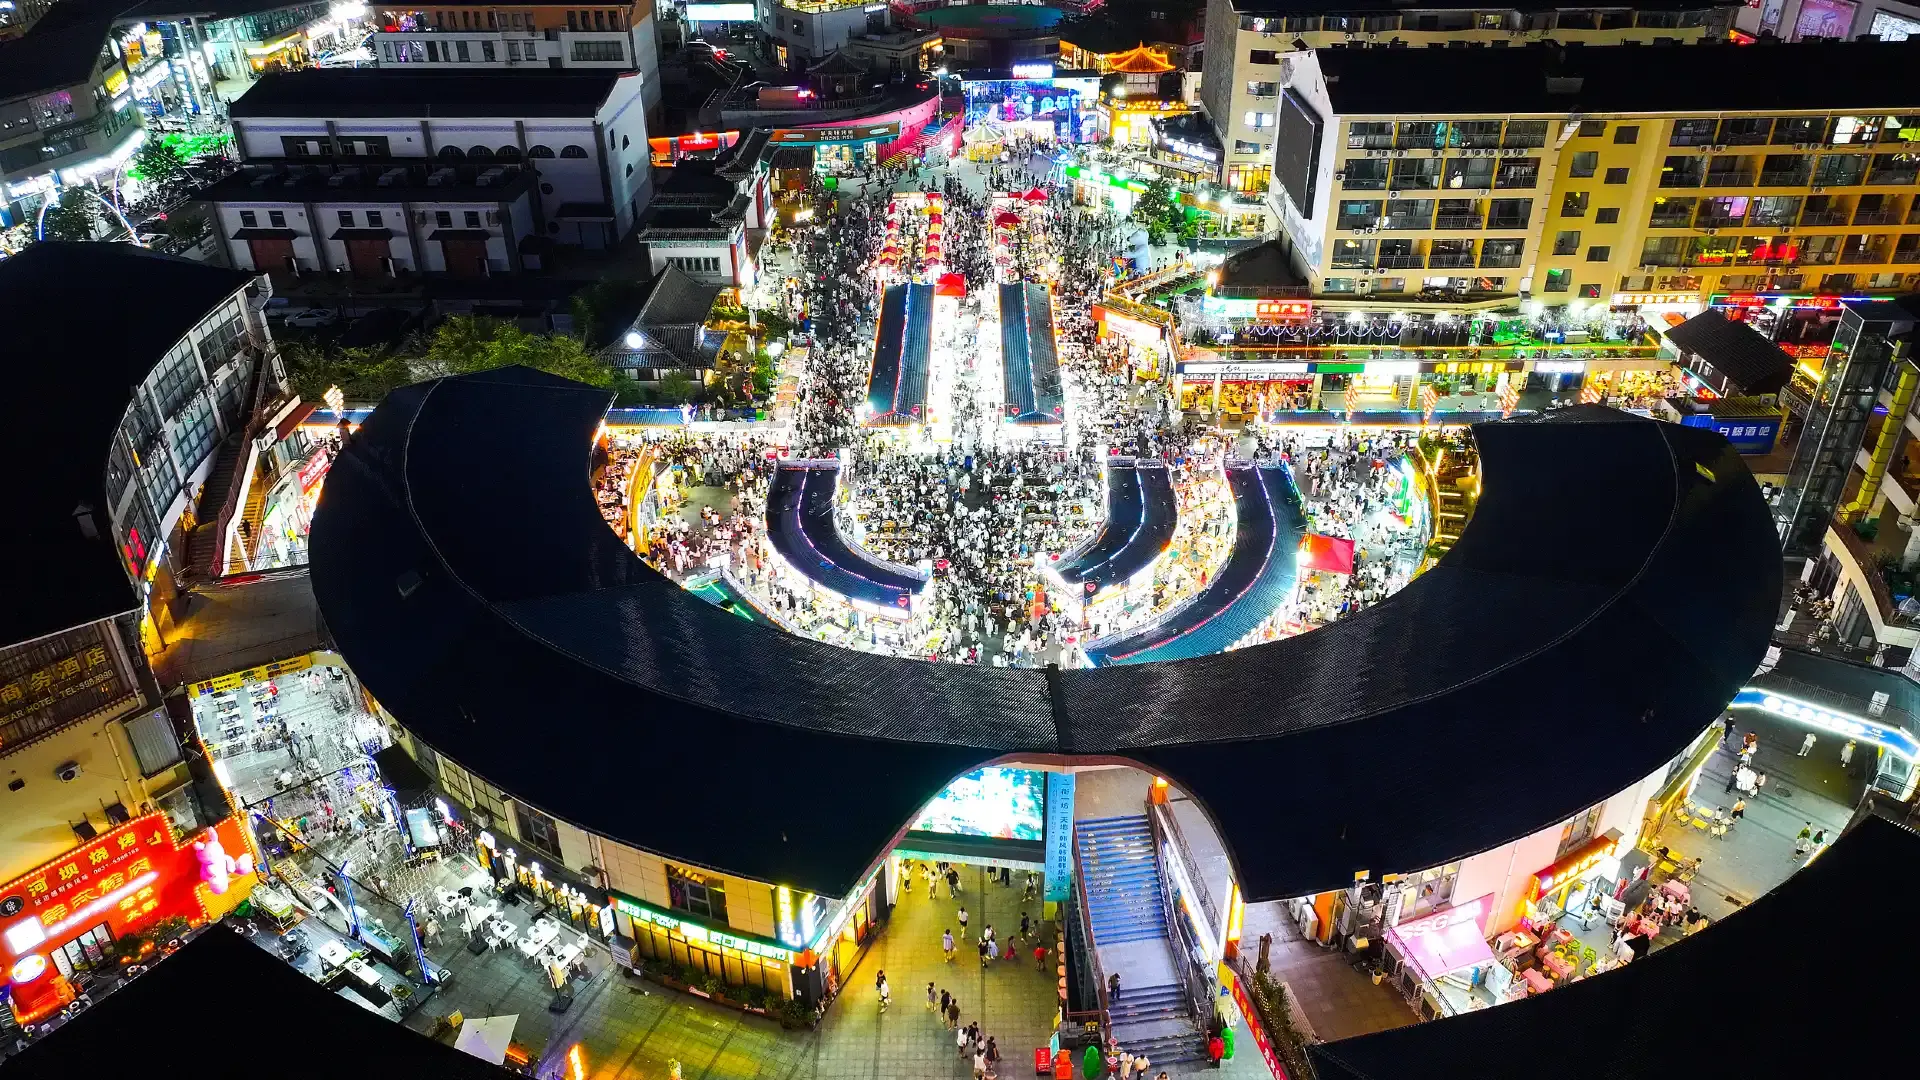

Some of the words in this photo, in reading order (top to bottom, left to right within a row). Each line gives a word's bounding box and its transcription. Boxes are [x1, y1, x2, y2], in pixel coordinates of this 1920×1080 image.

[0, 647, 105, 704] 商务酒店
[25, 694, 57, 714] HOTEL
[27, 831, 136, 898] 河坝烧烤
